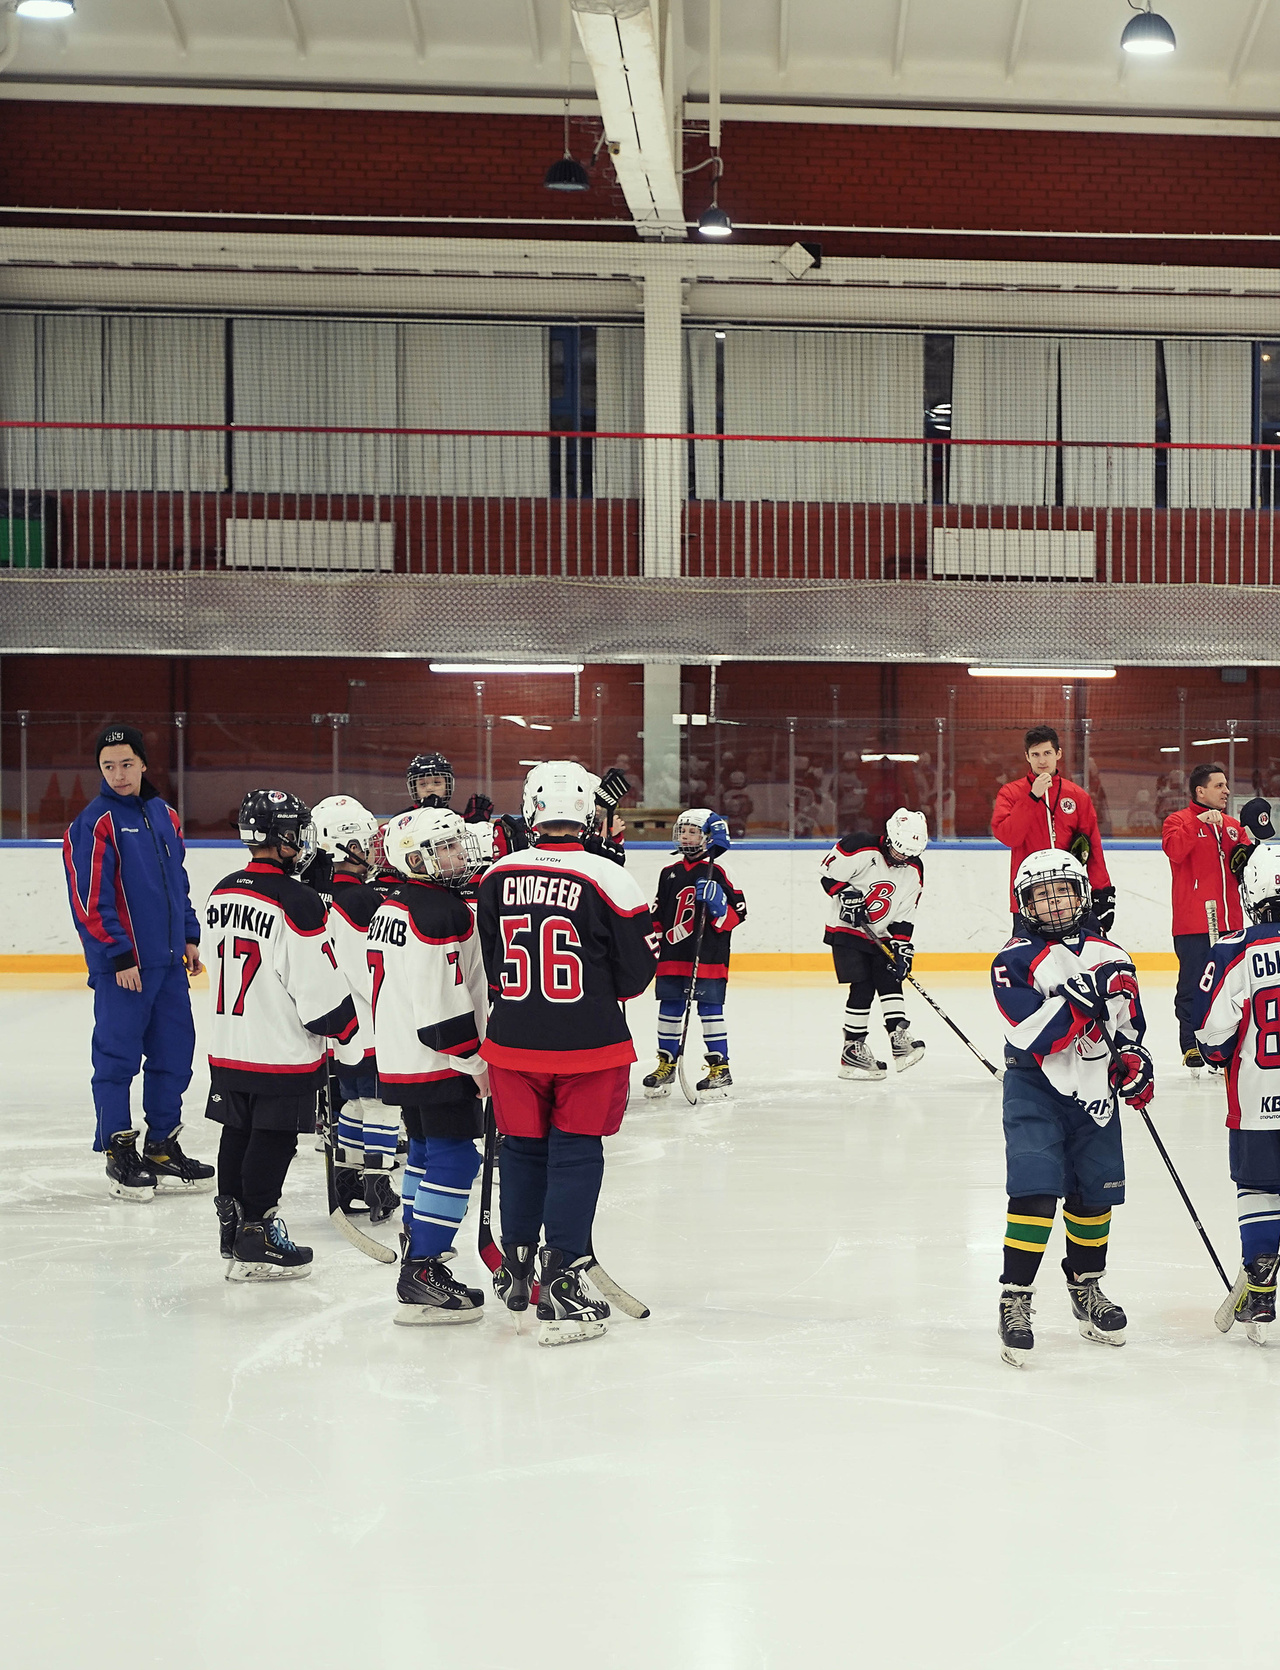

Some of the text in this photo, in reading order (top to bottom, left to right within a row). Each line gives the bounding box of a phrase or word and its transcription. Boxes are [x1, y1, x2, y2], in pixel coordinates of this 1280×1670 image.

[503, 875, 582, 911] СКОБЕЕВ
[217, 934, 263, 1017] 17
[446, 950, 464, 987] 7
[499, 913, 584, 1004] 56
